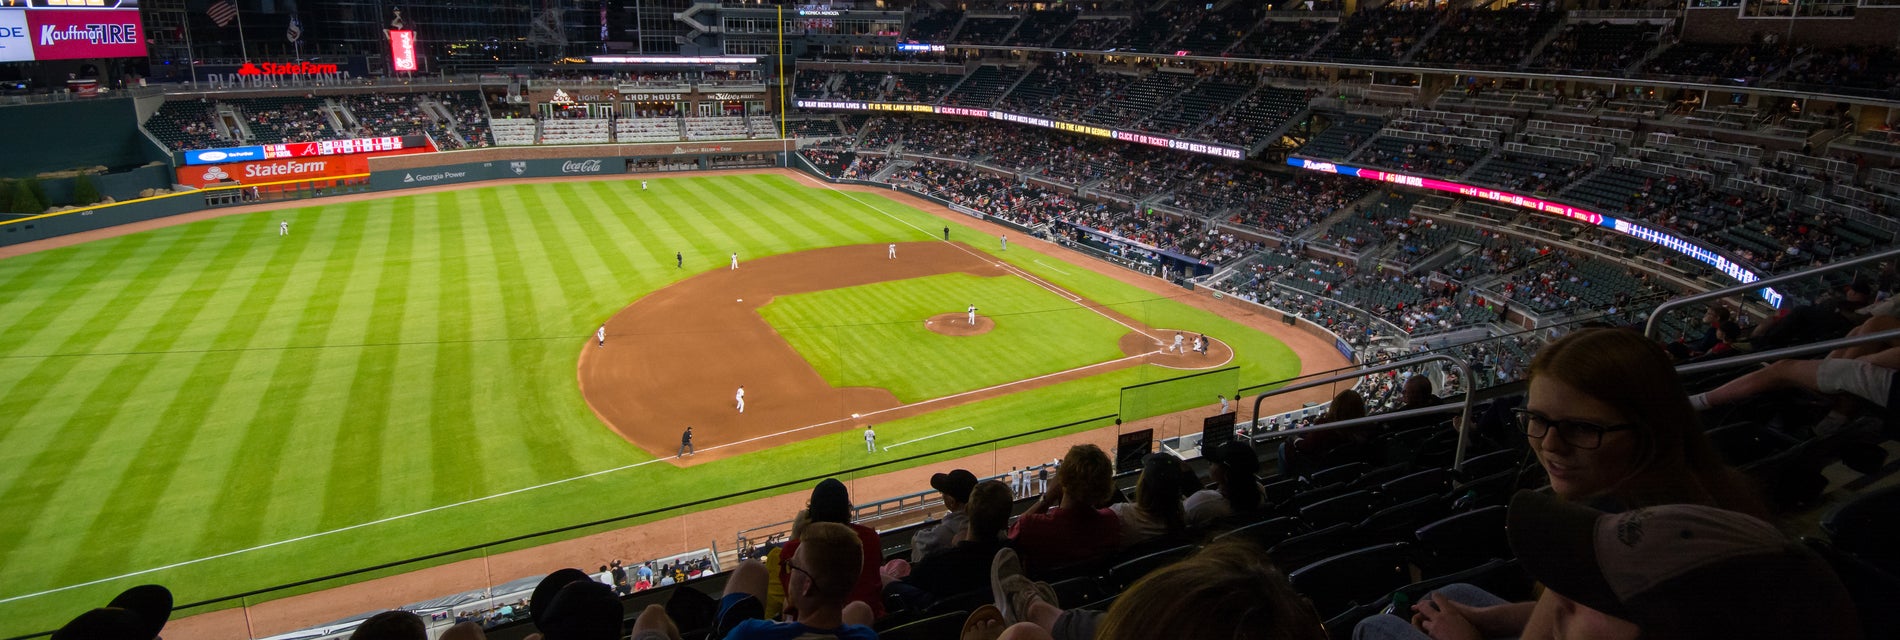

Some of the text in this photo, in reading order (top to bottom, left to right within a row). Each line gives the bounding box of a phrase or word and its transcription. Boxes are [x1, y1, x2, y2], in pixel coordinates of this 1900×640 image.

[41, 24, 137, 45] Kauffman TIRE
[942, 106, 955, 114] CLICK
[1092, 128, 1111, 137] GEORGIA
[1118, 132, 1133, 141] CLICK
[1134, 134, 1140, 142] IT
[1140, 135, 1147, 143] OR
[1148, 137, 1168, 147] TICKET!
[1176, 142, 1189, 150] SEAT
[1190, 144, 1207, 153] BELTS
[1208, 146, 1222, 155] SAVE
[1223, 148, 1240, 158] LIVES
[416, 173, 444, 182] Georgia
[1386, 174, 1395, 182] 46
[1395, 174, 1406, 184] IAN
[1407, 176, 1423, 187] KROL
